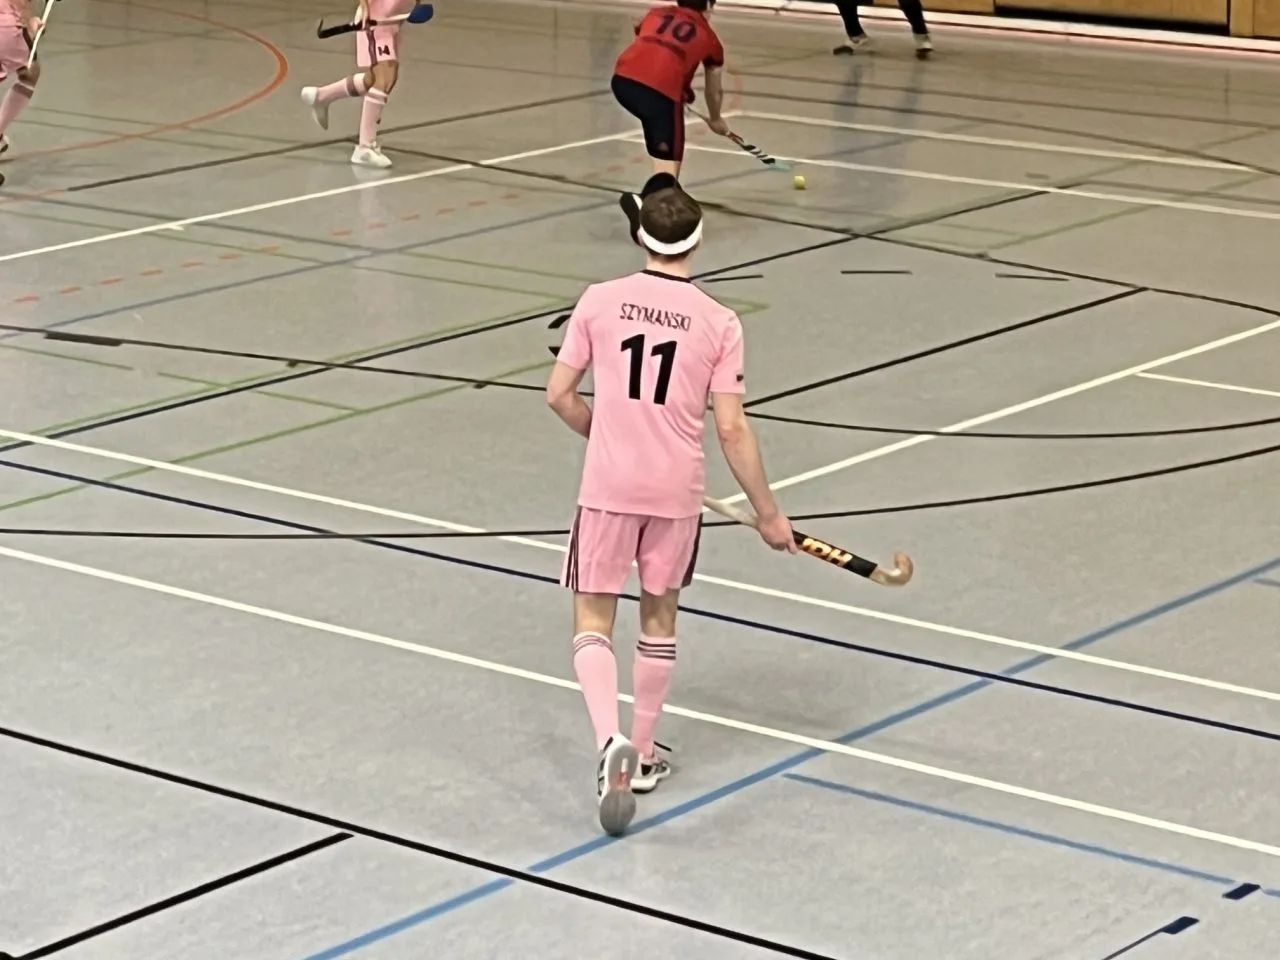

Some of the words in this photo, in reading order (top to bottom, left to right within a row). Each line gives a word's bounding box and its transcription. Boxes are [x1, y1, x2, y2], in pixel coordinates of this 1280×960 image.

[656, 14, 697, 43] 10
[377, 44, 391, 56] 14
[620, 333, 677, 405] 11
